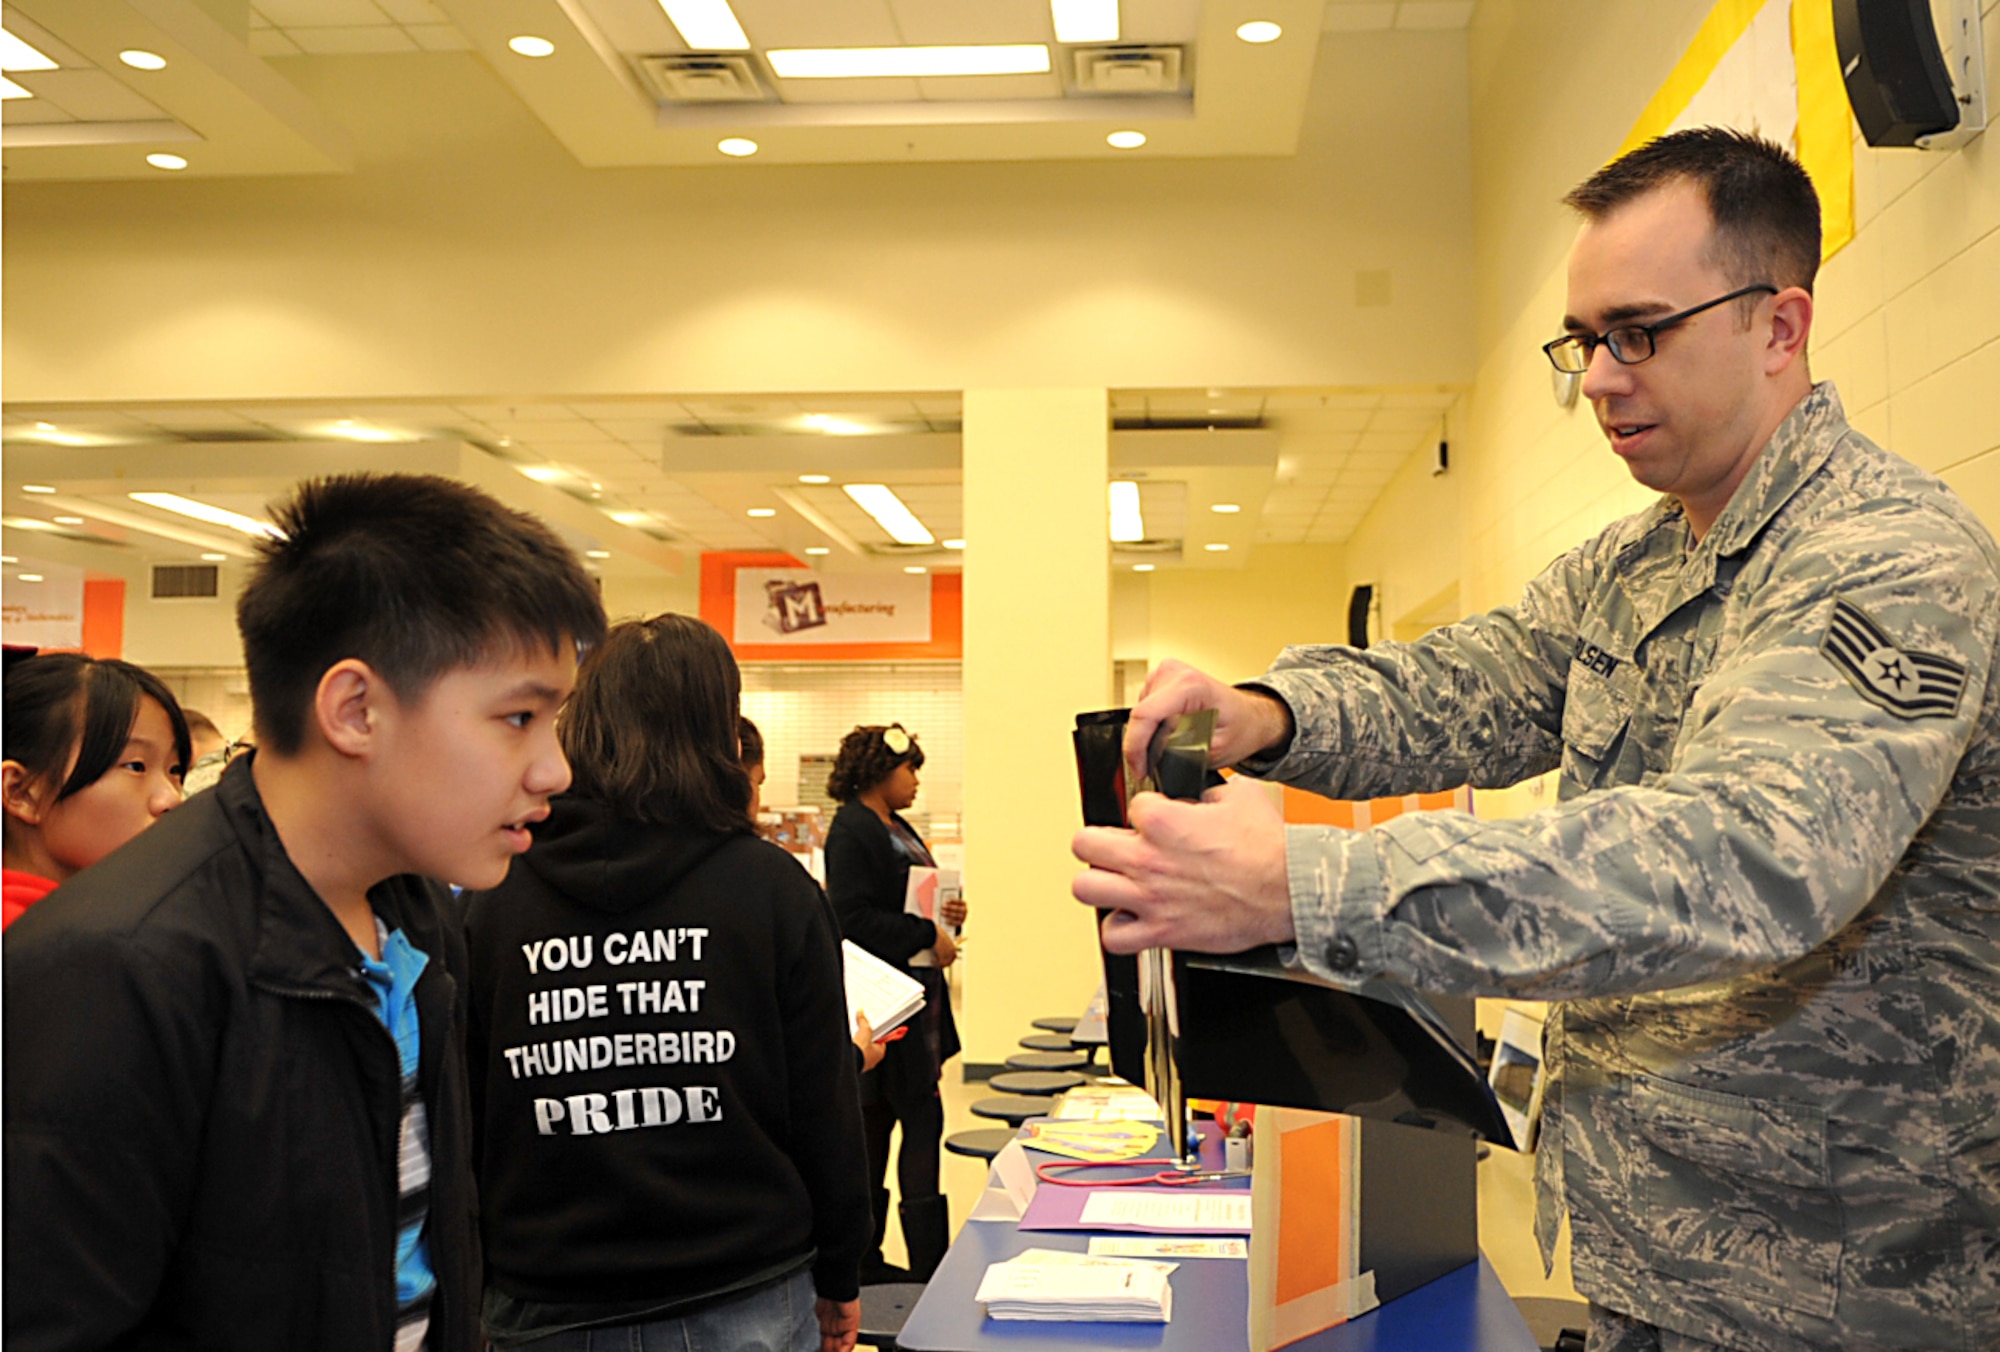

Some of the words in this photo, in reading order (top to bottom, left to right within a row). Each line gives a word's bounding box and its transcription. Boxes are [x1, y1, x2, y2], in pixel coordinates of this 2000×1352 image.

[522, 936, 592, 974] YOU
[604, 928, 708, 965] CAN'T
[529, 985, 608, 1025] HIDE
[616, 980, 705, 1014] THAT
[504, 1031, 735, 1078] THUNDERBIRD
[534, 1087, 722, 1134] PRIDE
